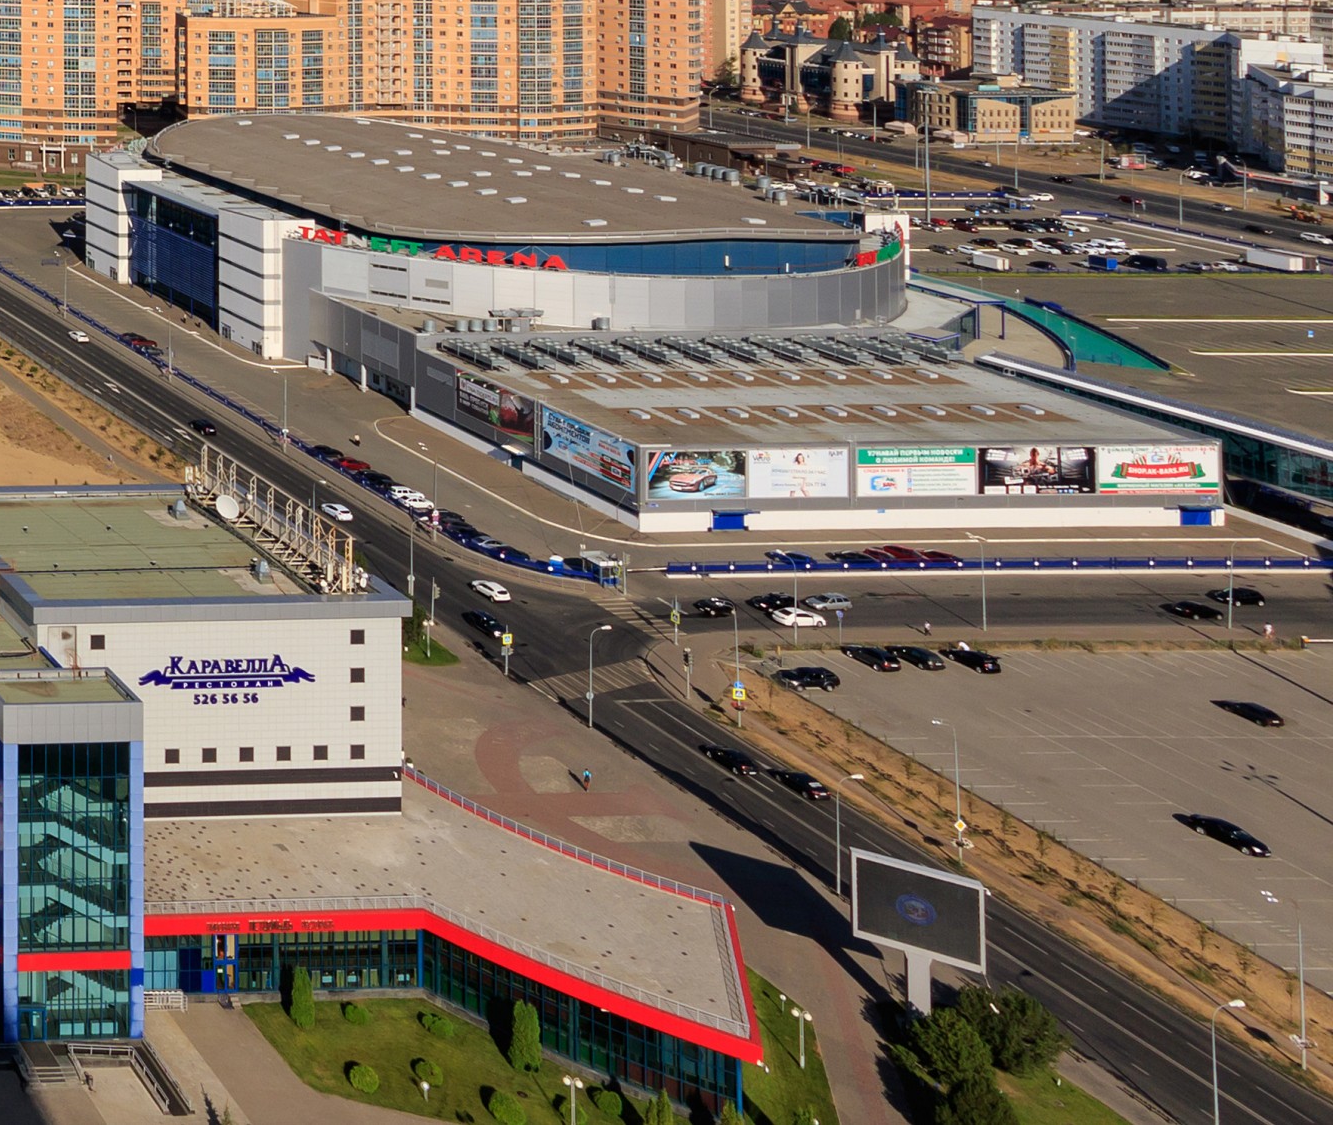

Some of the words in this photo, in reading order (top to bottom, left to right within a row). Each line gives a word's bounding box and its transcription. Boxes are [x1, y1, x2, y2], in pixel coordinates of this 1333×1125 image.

[298, 226, 424, 256] TATNEFT
[435, 244, 570, 270] ARENA
[183, 680, 274, 689] РЕСТОРАН
[193, 694, 218, 705] 526
[222, 693, 238, 704] 56
[242, 692, 259, 703] 56
